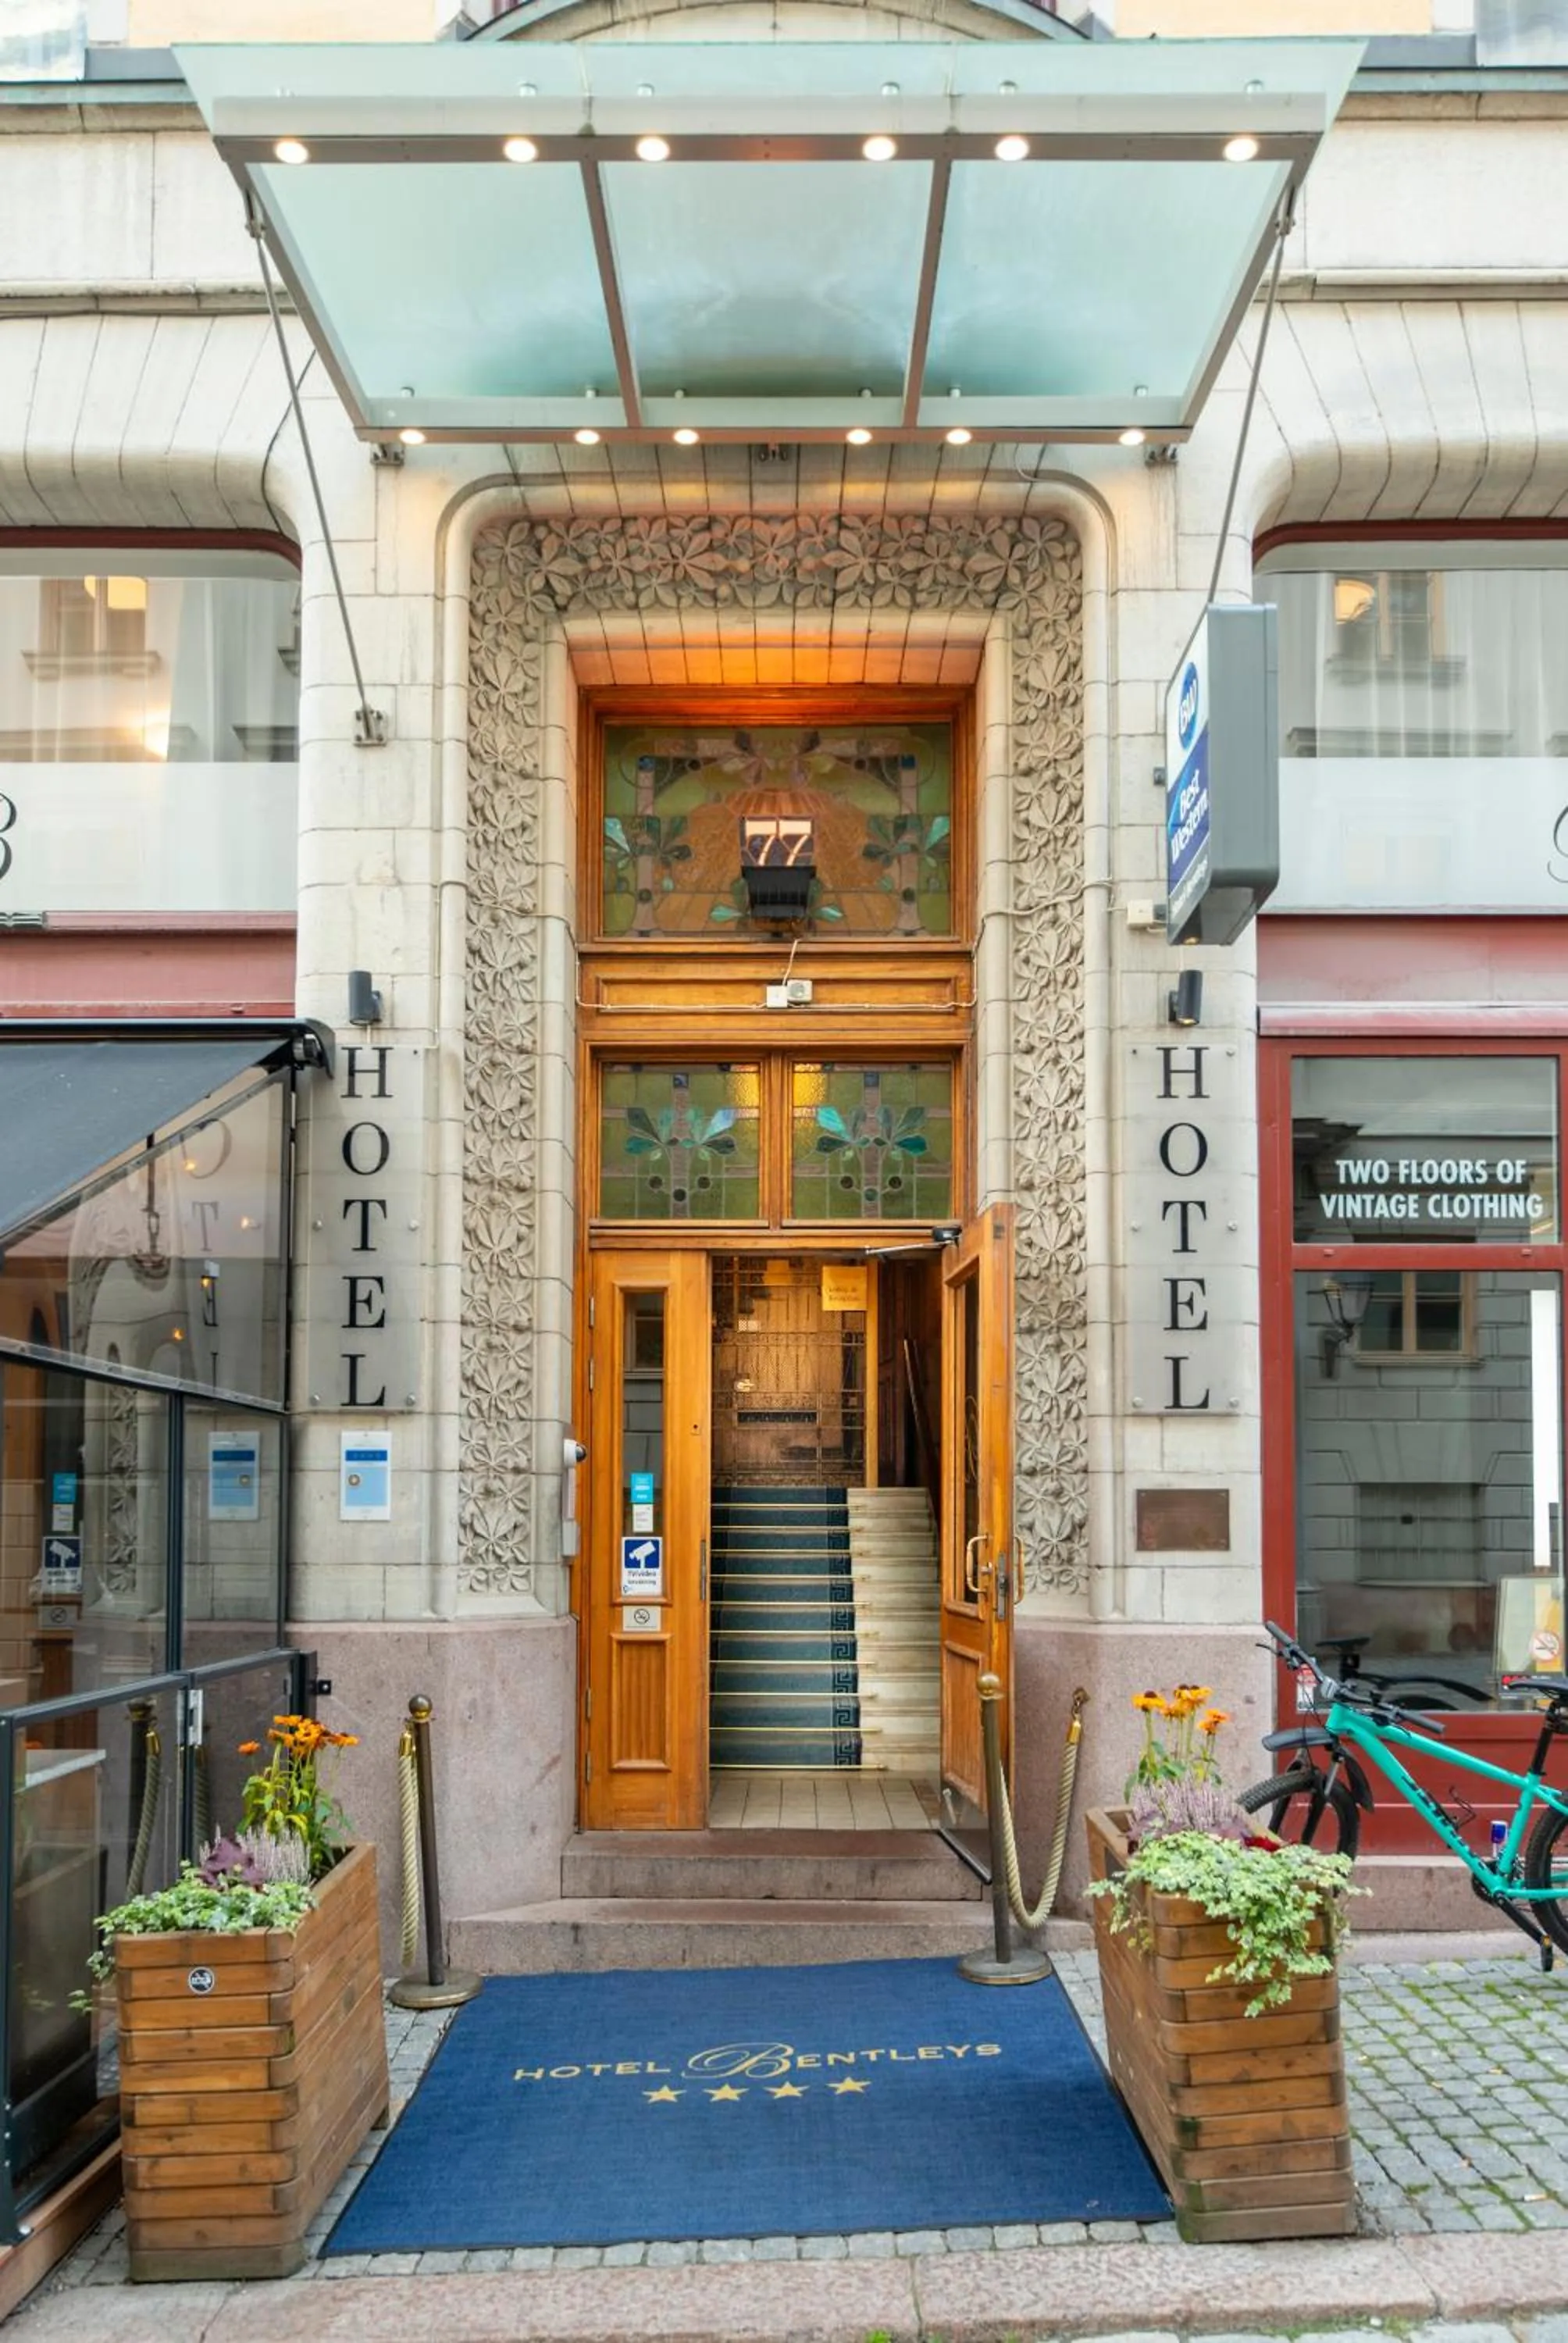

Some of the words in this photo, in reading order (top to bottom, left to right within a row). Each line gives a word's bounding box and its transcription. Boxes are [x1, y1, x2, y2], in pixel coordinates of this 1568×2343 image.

[745, 820, 811, 866] 77
[1335, 1159, 1390, 1184] TWO
[1399, 1159, 1488, 1185] FLOORS
[1496, 1159, 1527, 1184] OF
[340, 1046, 394, 1407] HOTEL
[1320, 1194, 1420, 1218] VINTAGE
[1427, 1194, 1544, 1218] CLOTHING
[1156, 1046, 1210, 1410] HOTEL
[513, 2061, 671, 2081] HOTEL
[681, 2043, 1003, 2079] BENTLEYS
